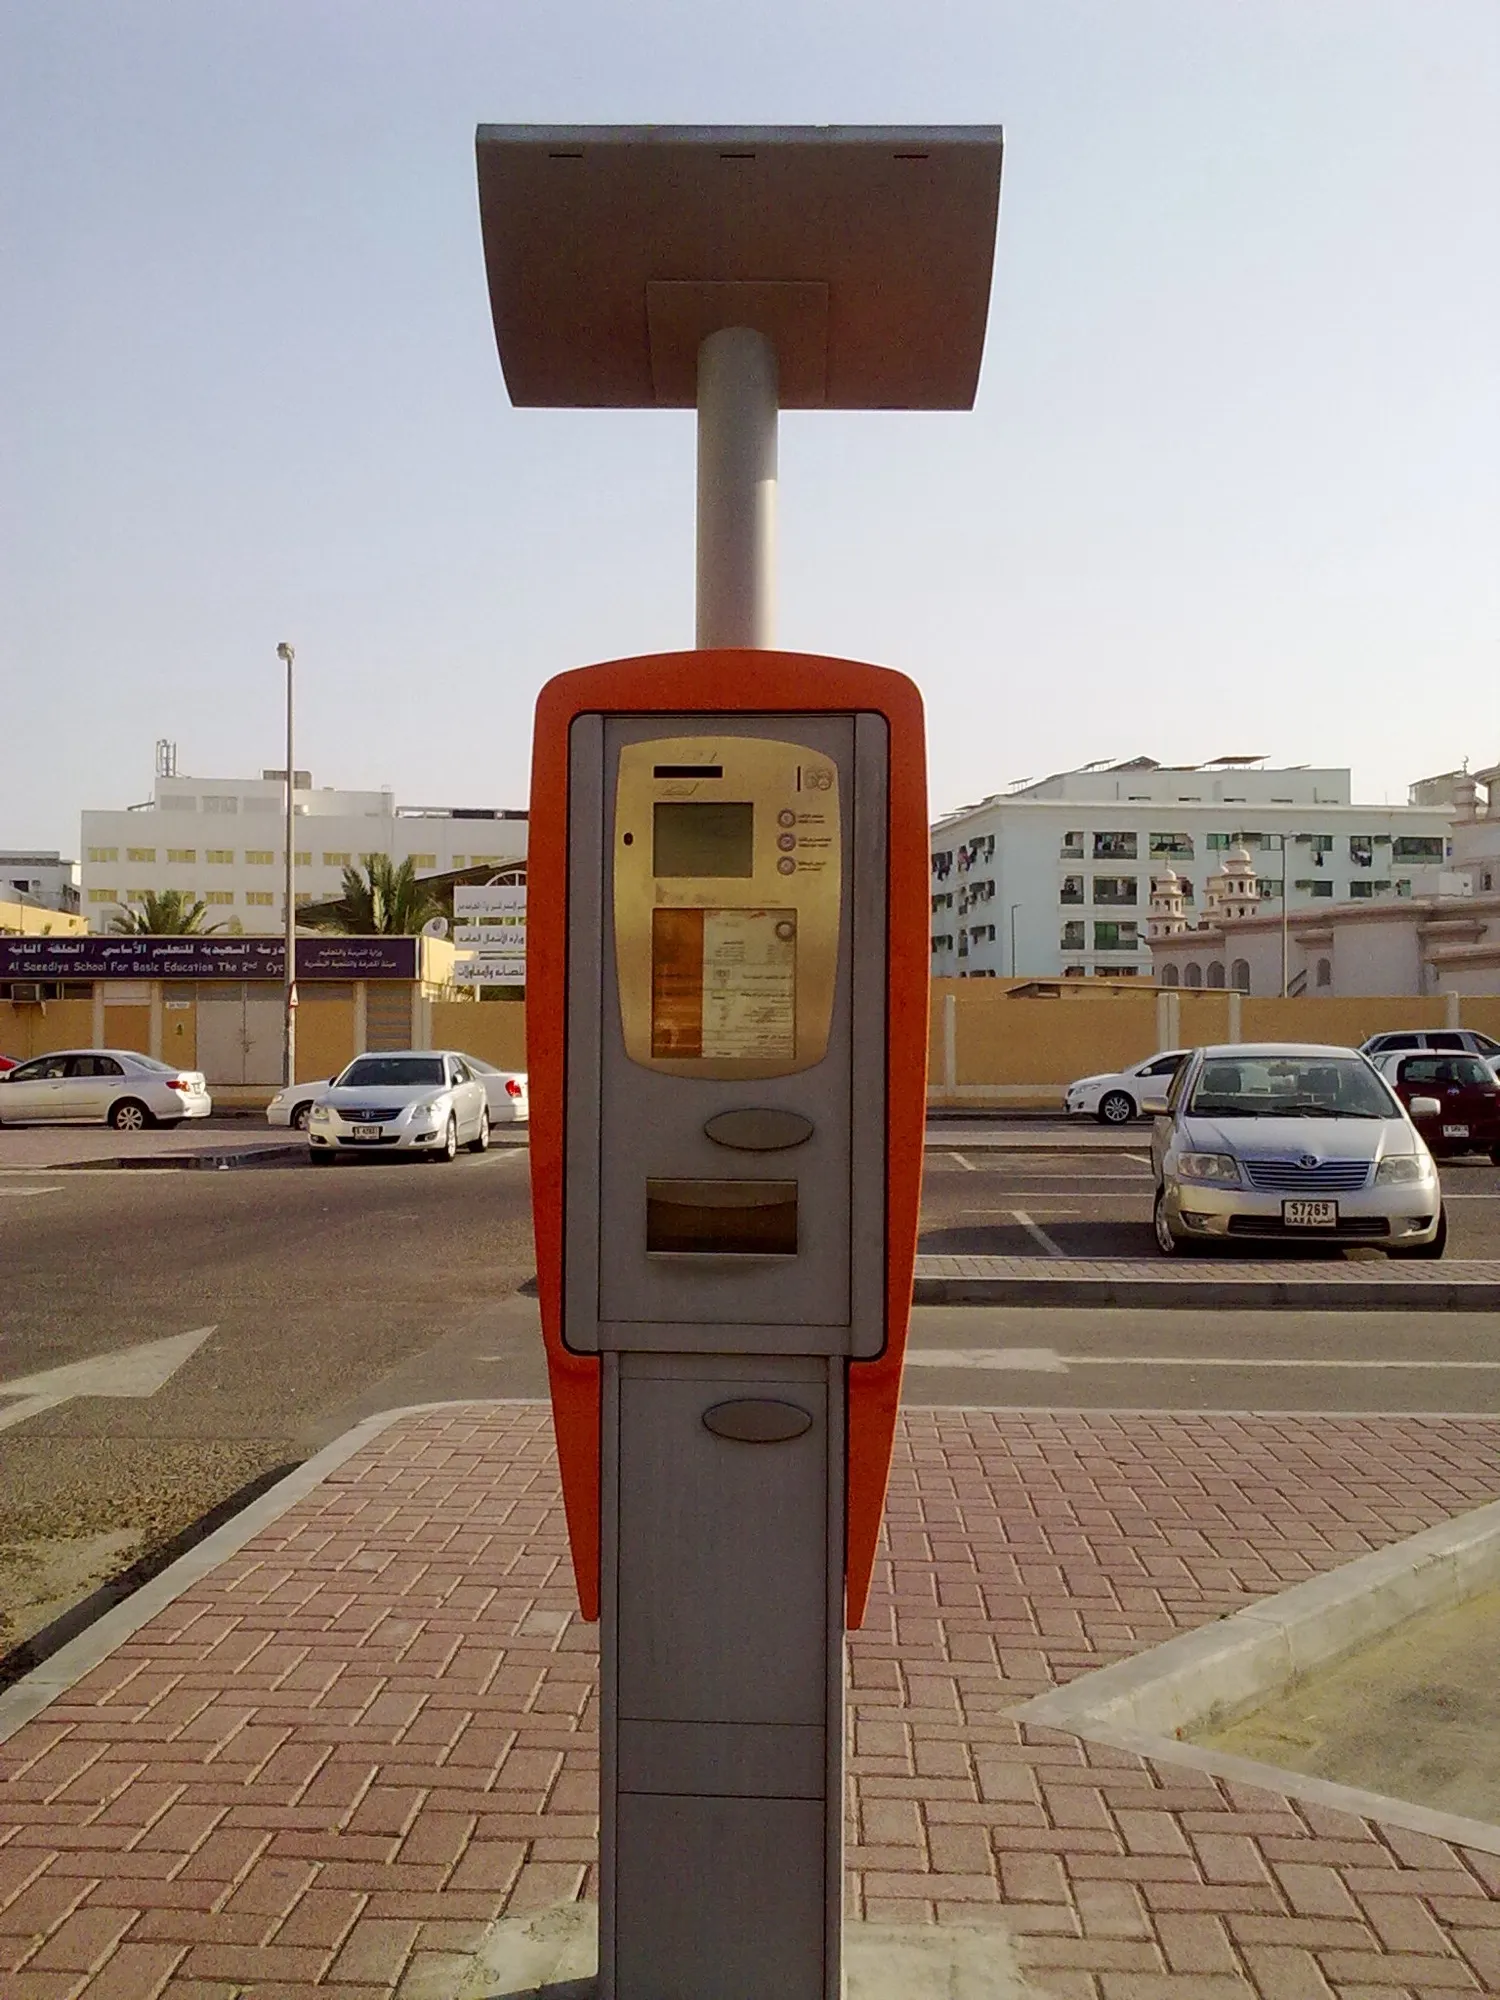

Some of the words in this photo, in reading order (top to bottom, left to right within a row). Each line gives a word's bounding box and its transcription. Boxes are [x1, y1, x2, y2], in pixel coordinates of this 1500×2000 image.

[102, 941, 147, 958] الأساسي
[152, 943, 194, 958] للتعليم
[74, 961, 107, 972] School
[111, 961, 129, 972] For
[133, 961, 160, 972] Basic
[164, 961, 214, 972] Education
[218, 961, 238, 972] The
[266, 961, 285, 975] Cyc
